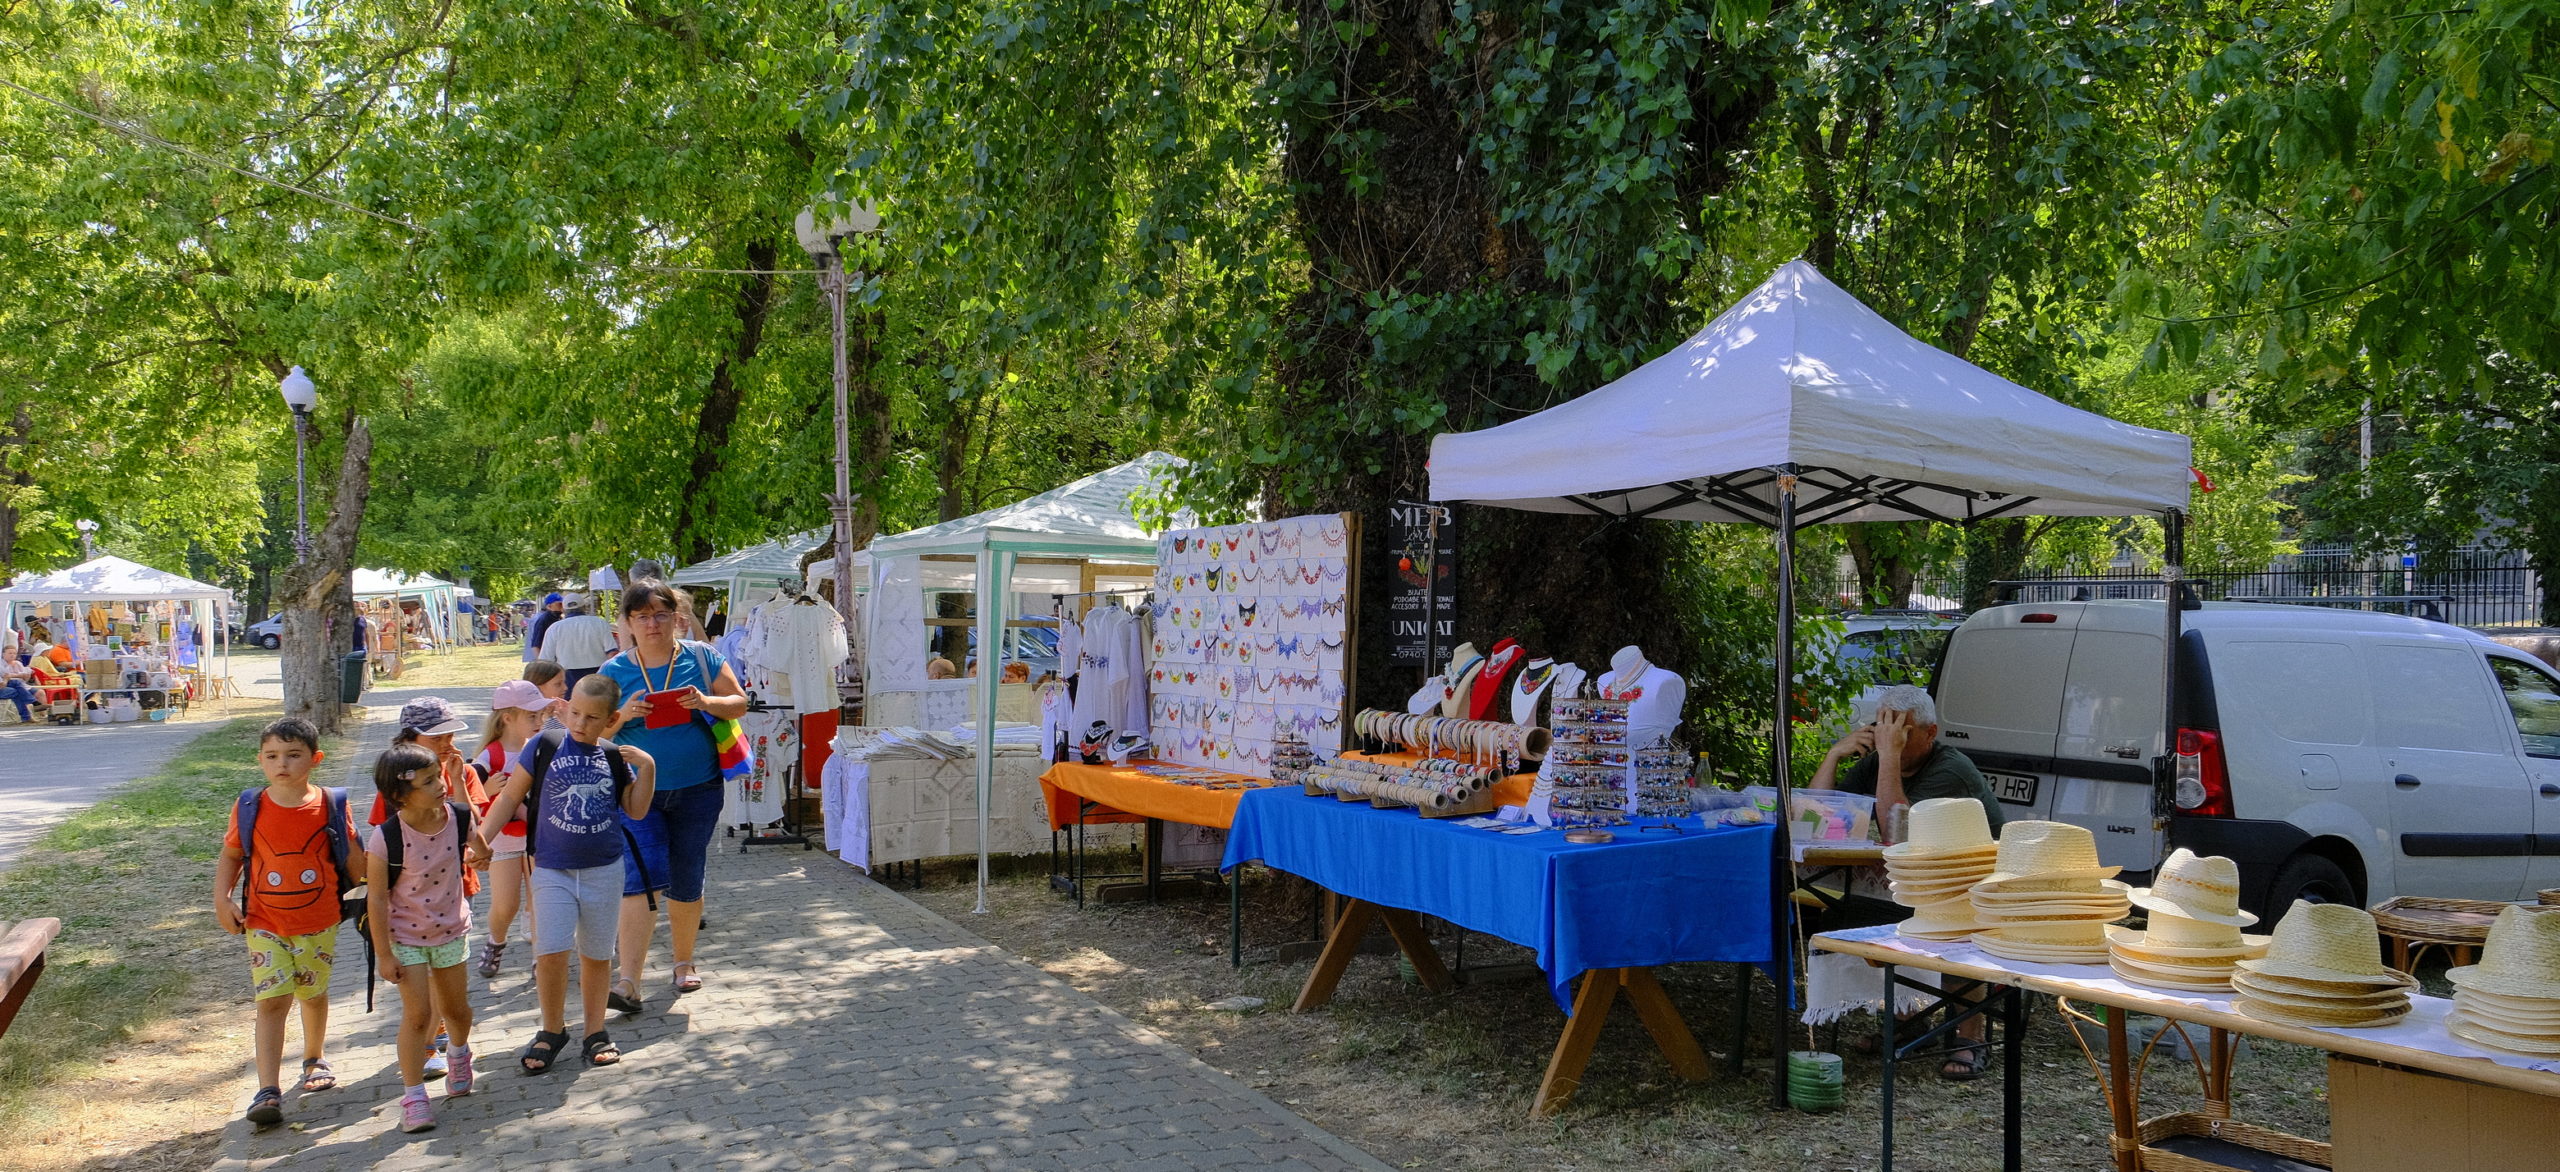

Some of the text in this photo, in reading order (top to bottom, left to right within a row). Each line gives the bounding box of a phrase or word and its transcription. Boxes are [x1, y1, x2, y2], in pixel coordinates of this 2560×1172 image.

[1945, 730, 1970, 740] DACIA
[550, 755, 580, 773] FIRST
[2003, 777, 2034, 800] HRI
[548, 814, 587, 834] JURASSIC
